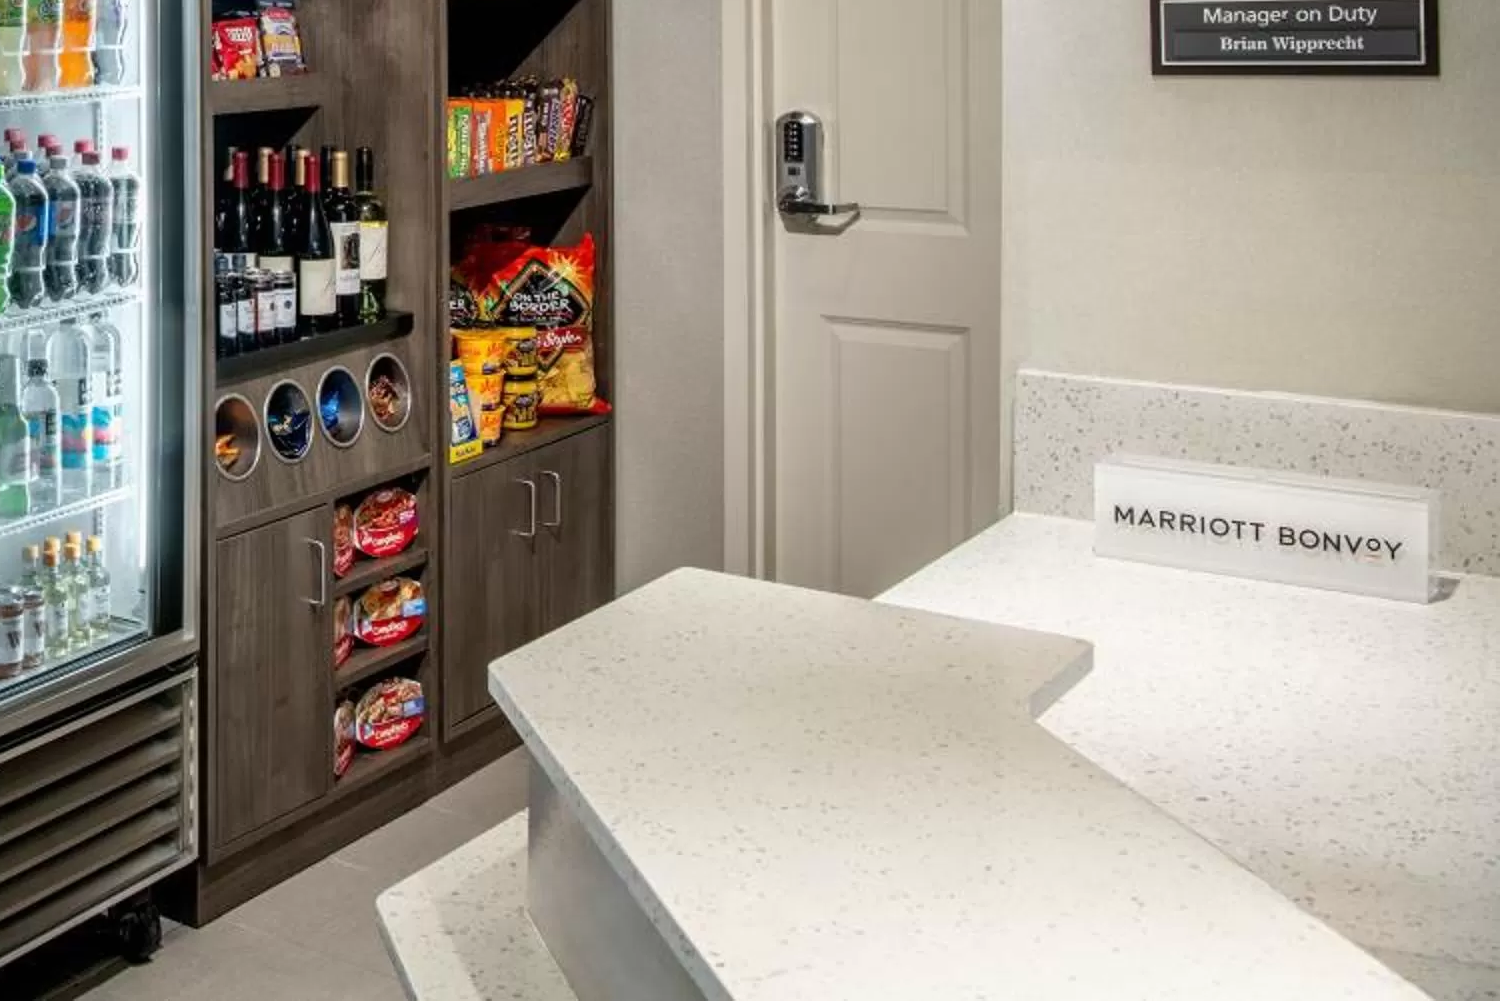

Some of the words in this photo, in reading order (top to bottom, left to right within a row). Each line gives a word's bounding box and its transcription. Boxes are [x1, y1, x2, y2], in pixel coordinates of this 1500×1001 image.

[1202, 7, 1288, 27] Manager
[1295, 9, 1321, 23] on
[1329, 5, 1378, 26] Duty
[1220, 36, 1267, 51] Brian
[1272, 35, 1365, 54] Wipprecht
[1113, 505, 1265, 542] MARRIOTT
